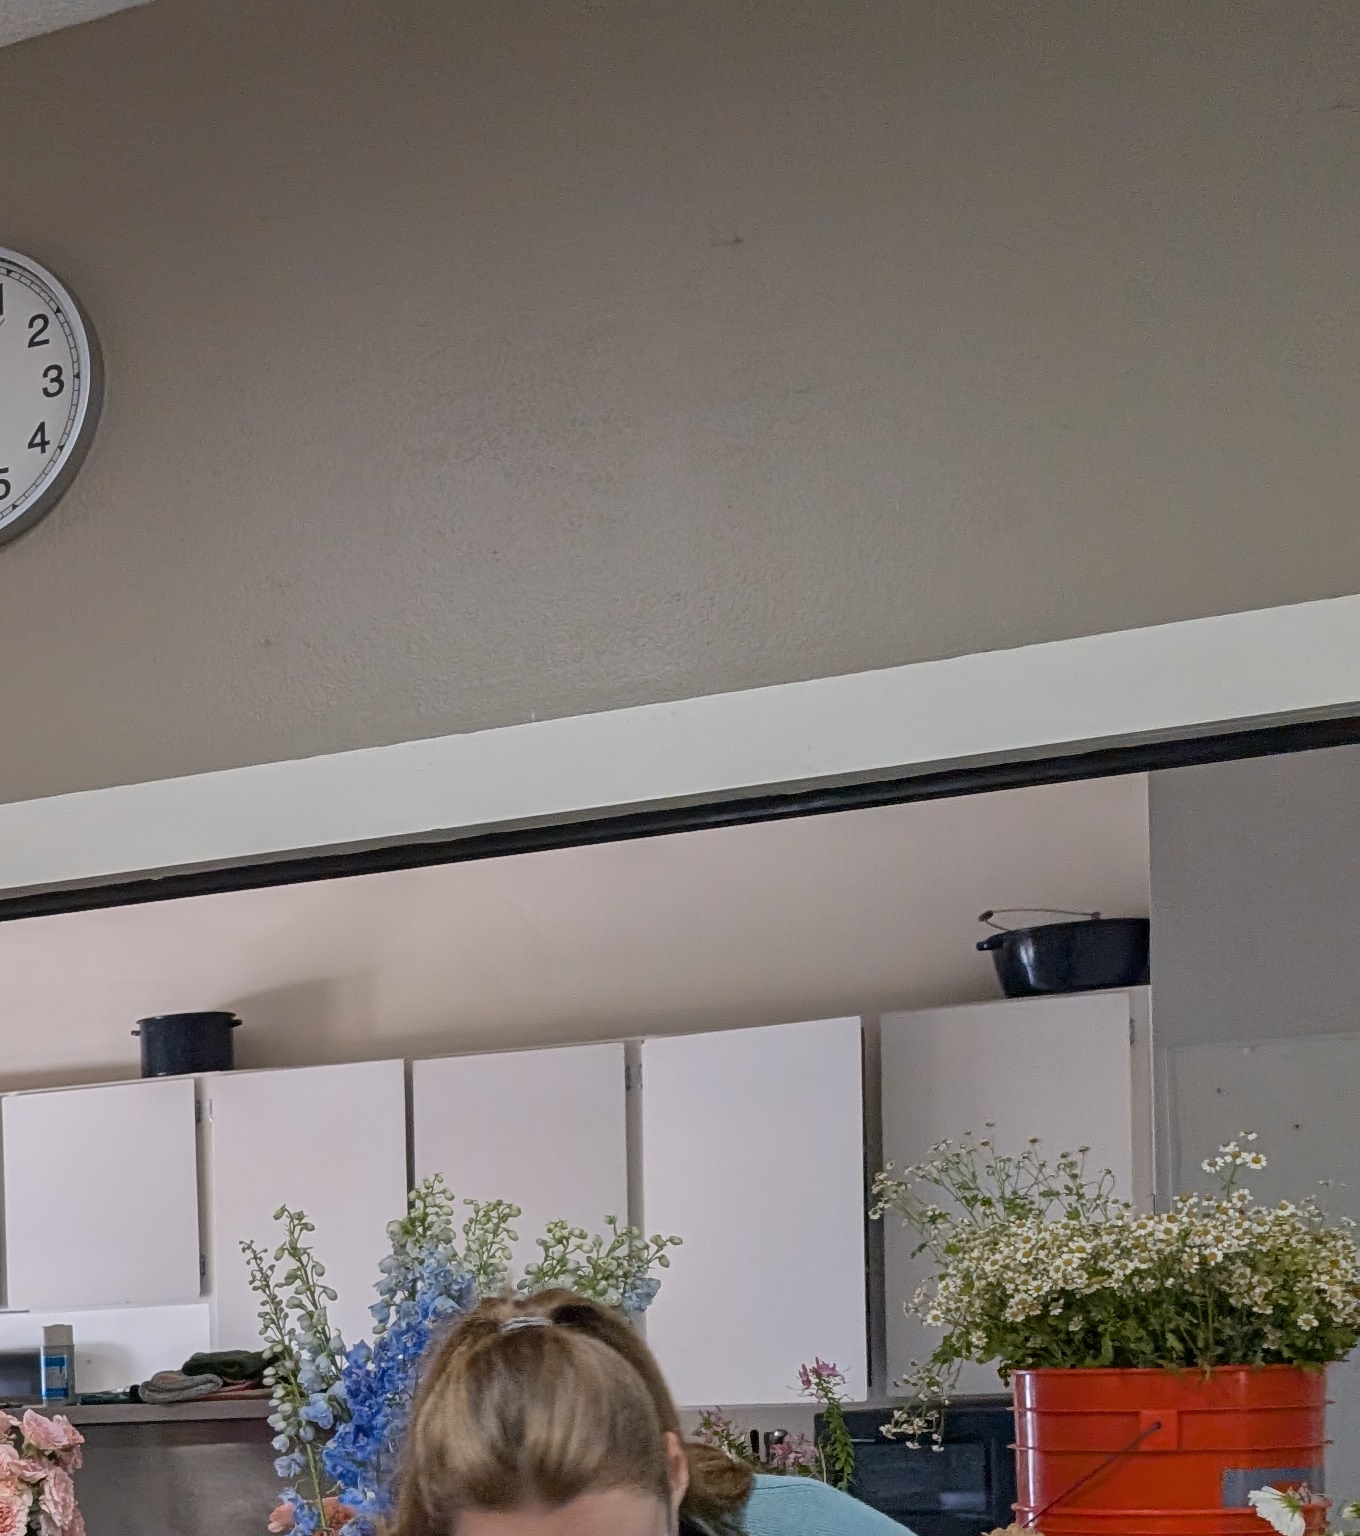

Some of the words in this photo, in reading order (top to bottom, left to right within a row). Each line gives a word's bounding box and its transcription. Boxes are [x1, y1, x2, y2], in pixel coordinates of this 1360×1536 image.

[27, 314, 50, 348] 2
[42, 364, 65, 398] 3
[27, 422, 50, 454] 4
